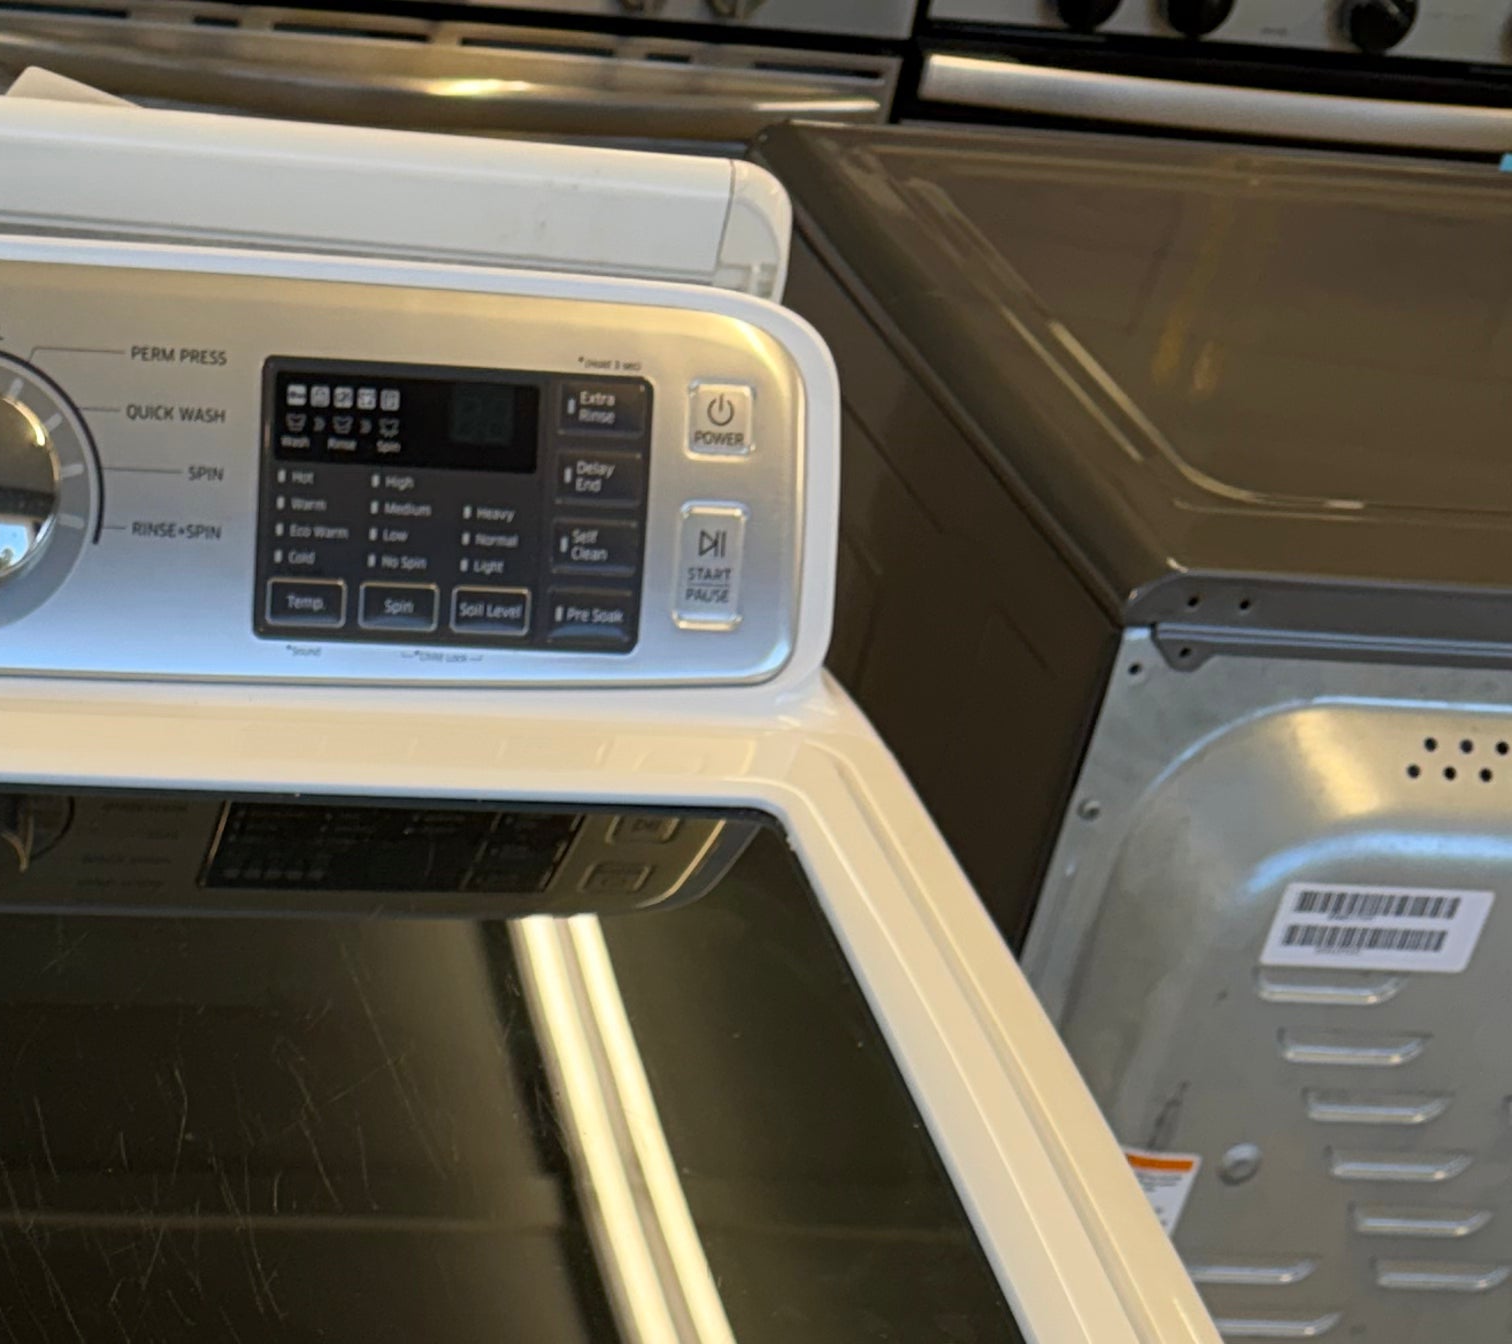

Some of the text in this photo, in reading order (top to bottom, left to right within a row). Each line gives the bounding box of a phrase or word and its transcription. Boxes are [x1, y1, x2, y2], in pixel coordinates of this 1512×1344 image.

[130, 345, 228, 367] PERM PRESS
[580, 391, 616, 406] Extra
[126, 403, 226, 424] QUICK WASH
[579, 408, 615, 424] Rinse
[694, 430, 745, 447] POWER
[187, 464, 224, 482] SPIN
[576, 460, 615, 479] Delay
[291, 471, 415, 490] Hot High
[575, 477, 602, 493] End
[291, 498, 516, 524] Warm Medium Heavy
[289, 524, 349, 540] Eco Warm
[382, 528, 519, 549] Low Normal
[572, 529, 598, 545] Self
[570, 545, 608, 561] Clean
[288, 551, 506, 575] Cold No Spin Light
[688, 568, 731, 582] START
[686, 588, 729, 603] PAUSE
[383, 599, 415, 614] Spin
[459, 602, 484, 618] Soil
[486, 604, 523, 619] Level
[566, 606, 624, 623] Pre Soak
